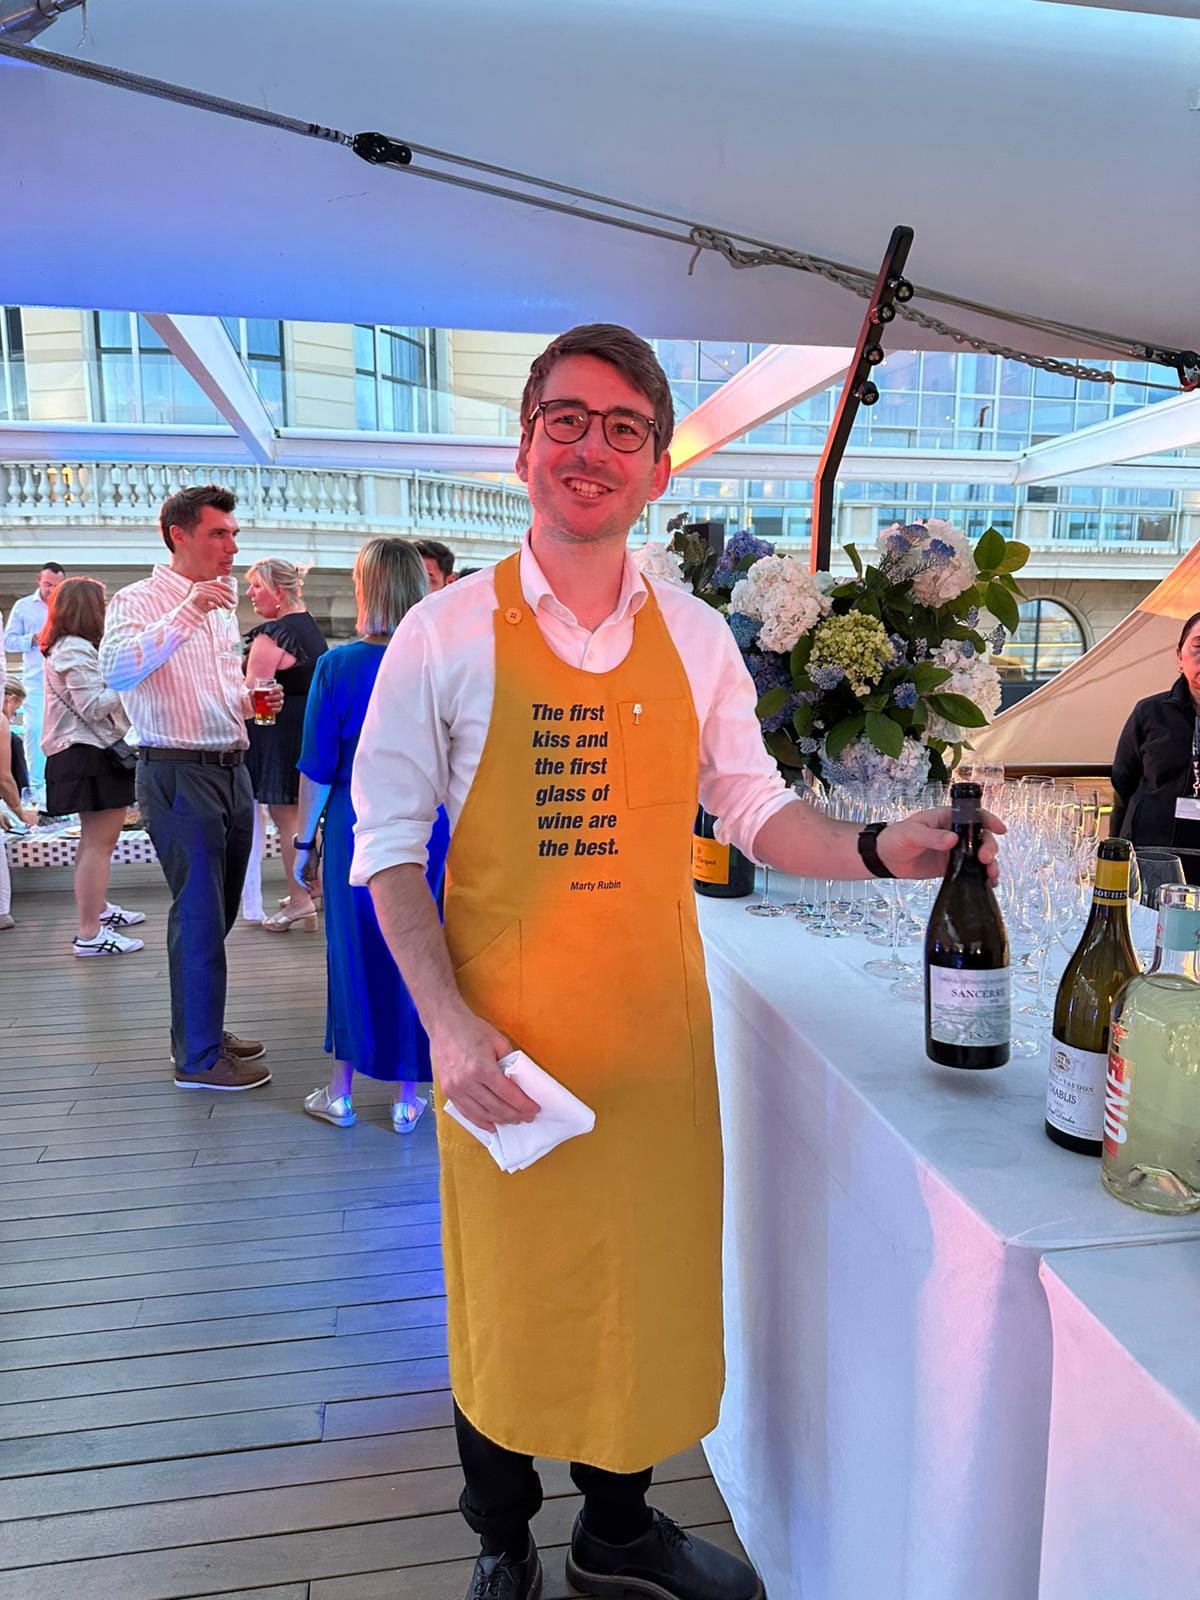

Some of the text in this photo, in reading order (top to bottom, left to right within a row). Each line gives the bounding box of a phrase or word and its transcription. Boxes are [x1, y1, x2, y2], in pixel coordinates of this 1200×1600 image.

[531, 703, 605, 722] The first
[532, 730, 609, 748] kiss and
[534, 757, 608, 775] the first
[535, 784, 610, 806] glass of
[537, 812, 617, 830] wine are
[538, 838, 619, 857] the best.
[570, 880, 621, 892] Marty Rubin
[1063, 1079, 1095, 1093] VAUDON
